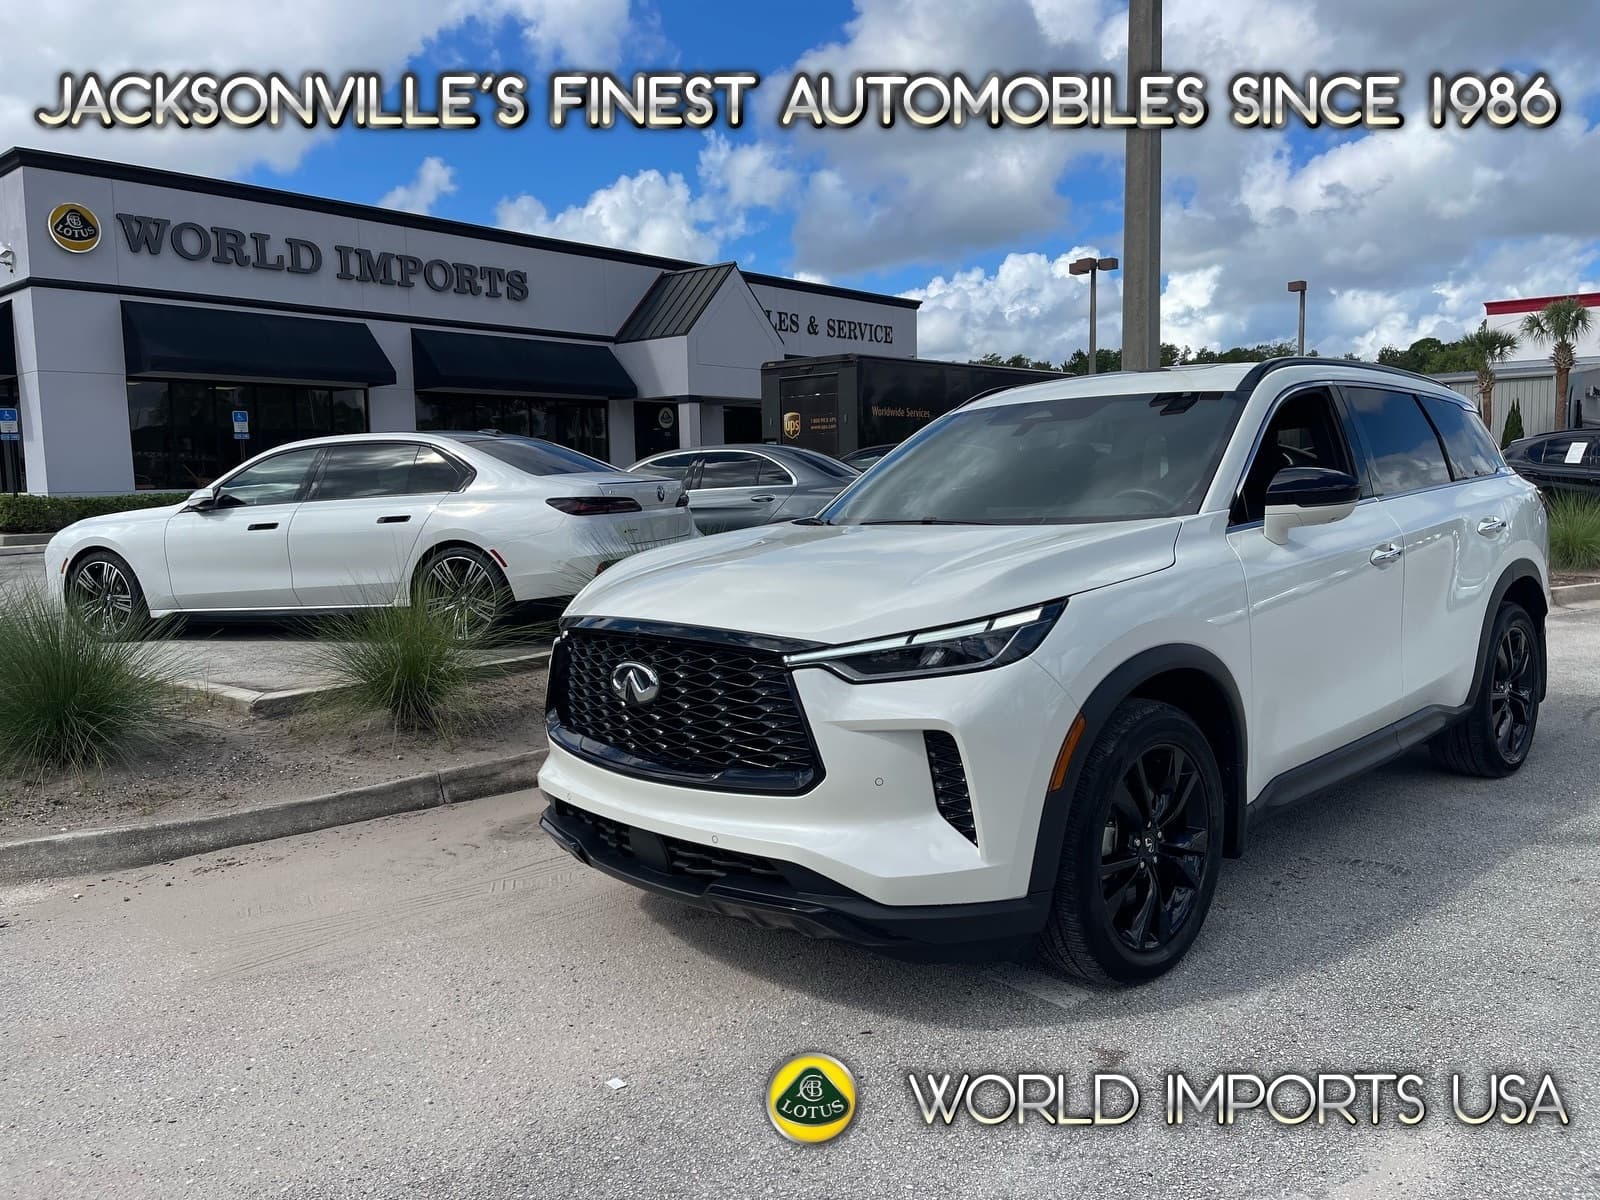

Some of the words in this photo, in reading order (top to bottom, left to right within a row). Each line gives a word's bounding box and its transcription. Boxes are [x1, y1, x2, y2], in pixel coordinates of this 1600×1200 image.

[56, 223, 95, 238] LOTUS
[115, 212, 323, 275] WORLD
[334, 244, 530, 301] IMPORTS
[807, 315, 819, 336] &
[826, 318, 894, 344] SERVICE
[785, 420, 800, 436] ups
